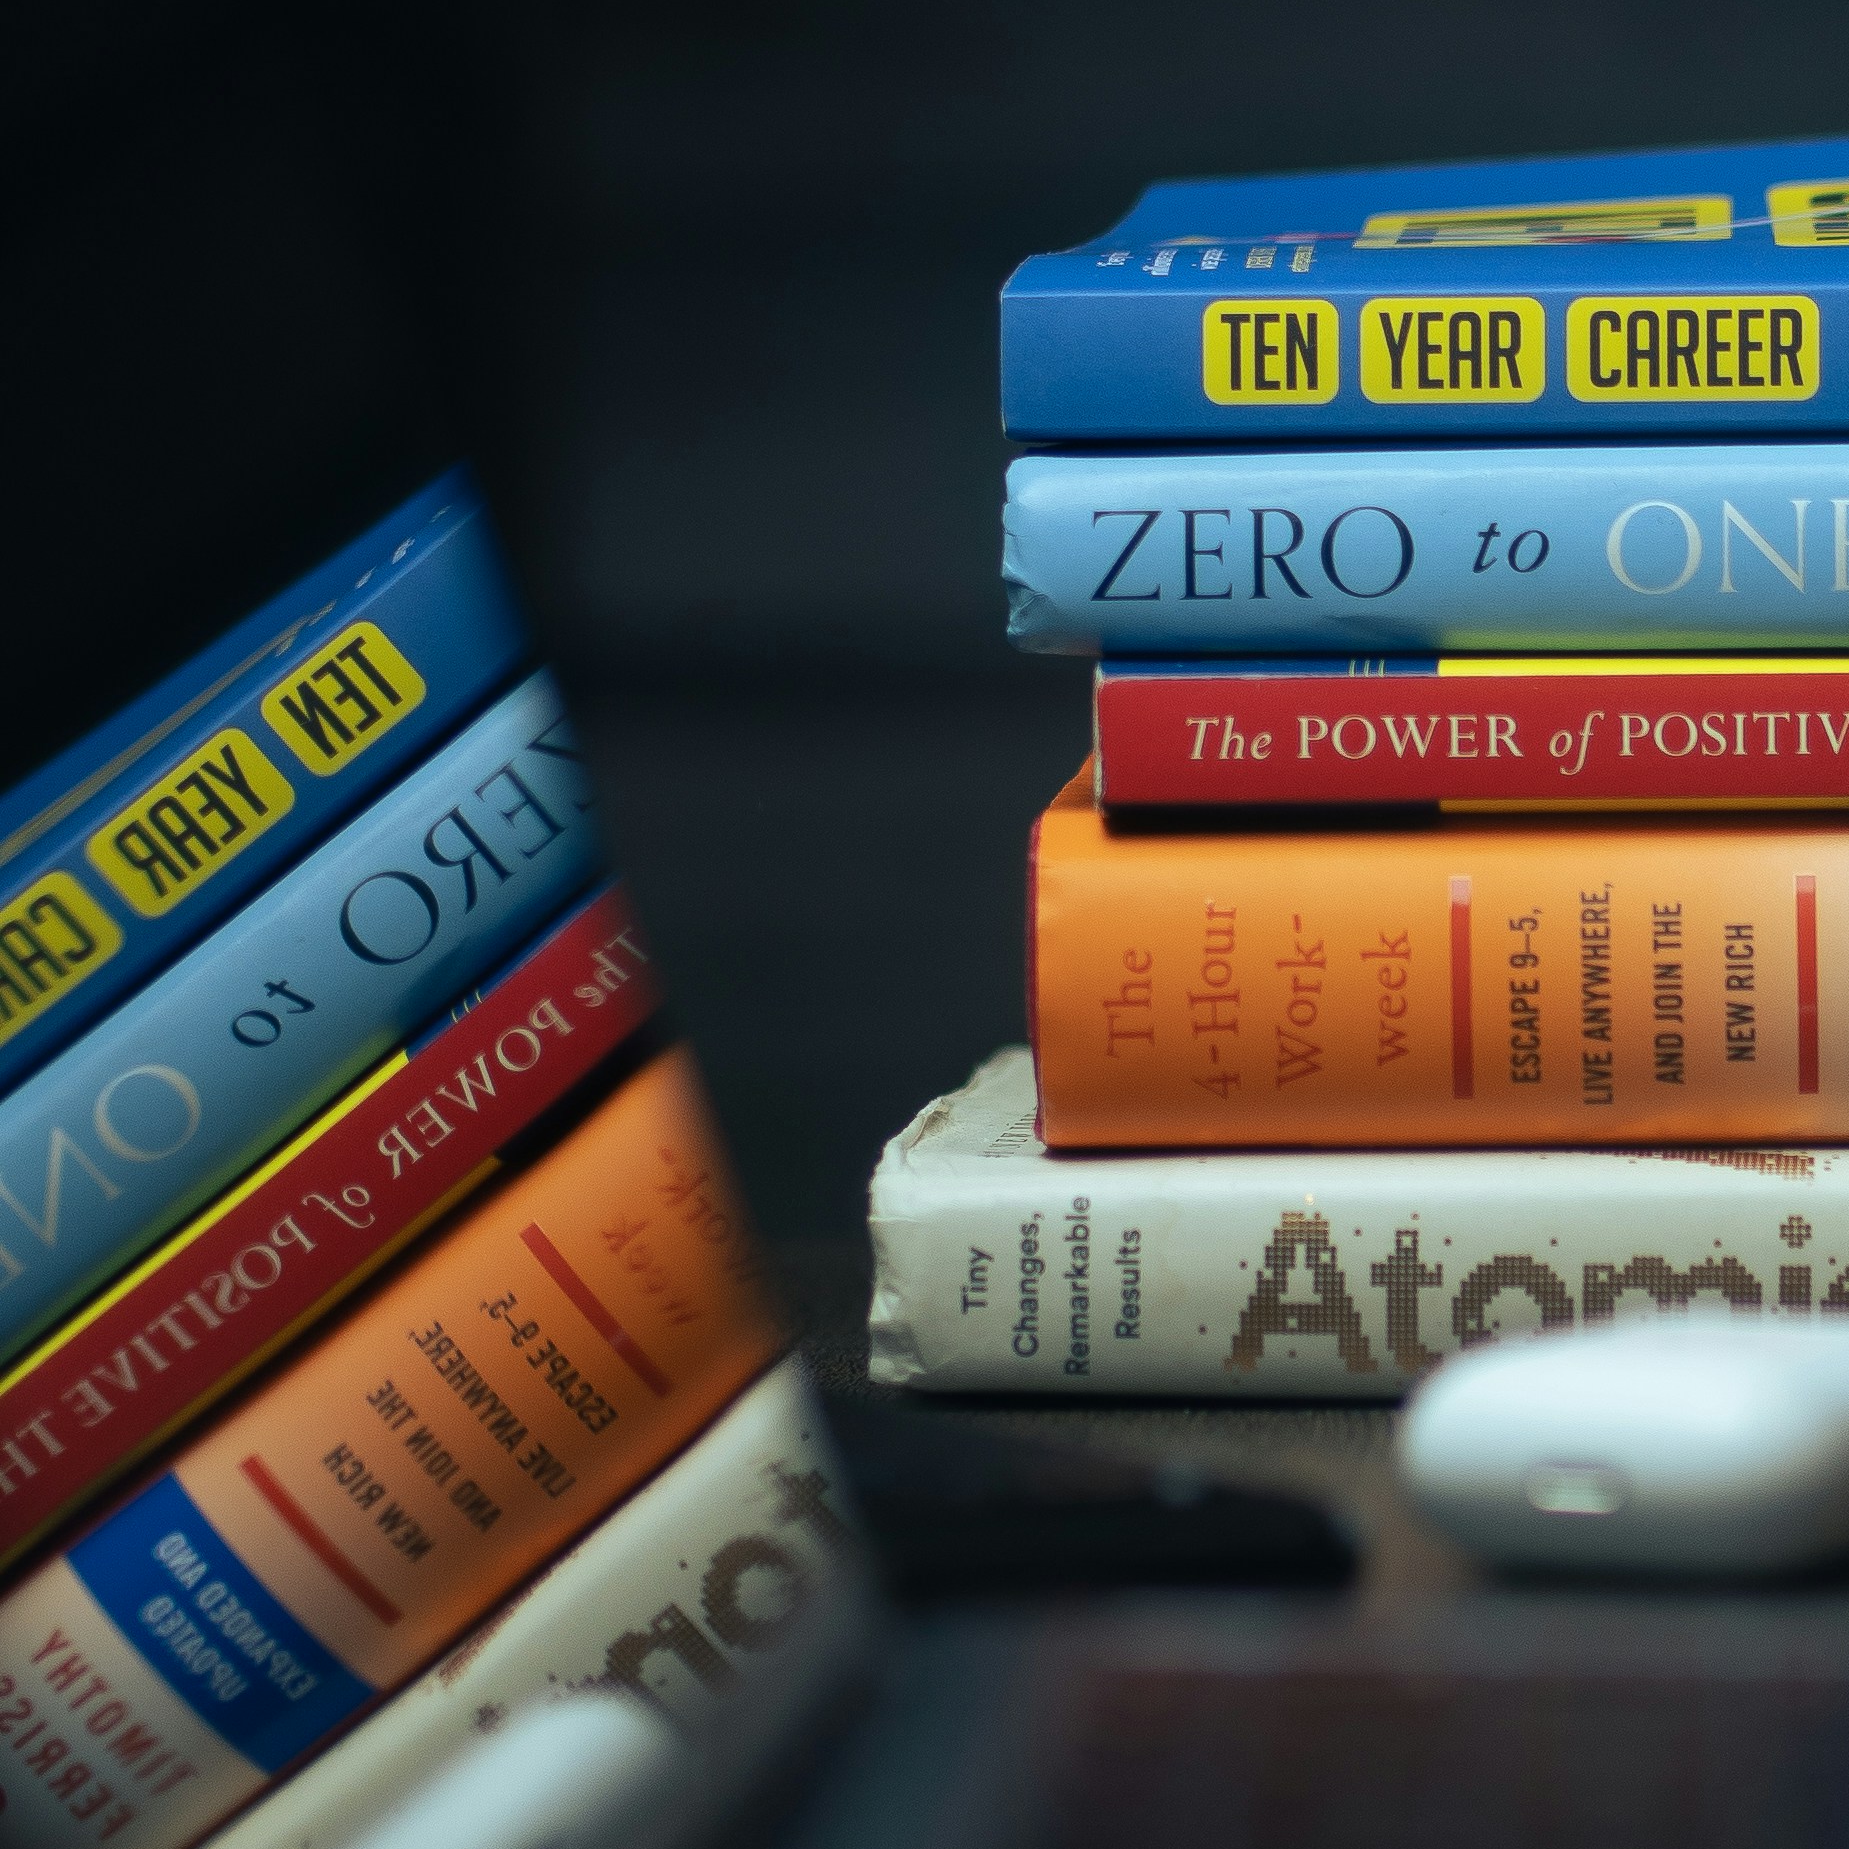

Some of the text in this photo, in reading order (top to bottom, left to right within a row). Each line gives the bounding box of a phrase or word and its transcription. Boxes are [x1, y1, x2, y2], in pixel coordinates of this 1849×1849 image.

[1221, 308, 1804, 391] TEN YEAR CAREER
[1090, 506, 1415, 601] ZERO
[1472, 522, 1550, 574] to
[1186, 716, 1273, 760] The
[1297, 715, 1523, 759] POWER
[1548, 710, 1605, 776] of
[1105, 948, 1154, 1058] The
[1187, 903, 1242, 1100] 4-Hour
[1274, 913, 1328, 1089] Work-
[1361, 929, 1412, 1067] week
[1509, 979, 1541, 1085] ESCAPE
[1580, 882, 1614, 1107] LIVE ANYWHERE,
[1652, 901, 1685, 1086] AND JOIN THE
[1725, 923, 1757, 1063] NEW RICH
[961, 1247, 993, 1314] Tiny
[1012, 1212, 1045, 1358] Changes,
[1064, 1196, 1092, 1377] Remarkable
[1115, 1228, 1142, 1340] Results
